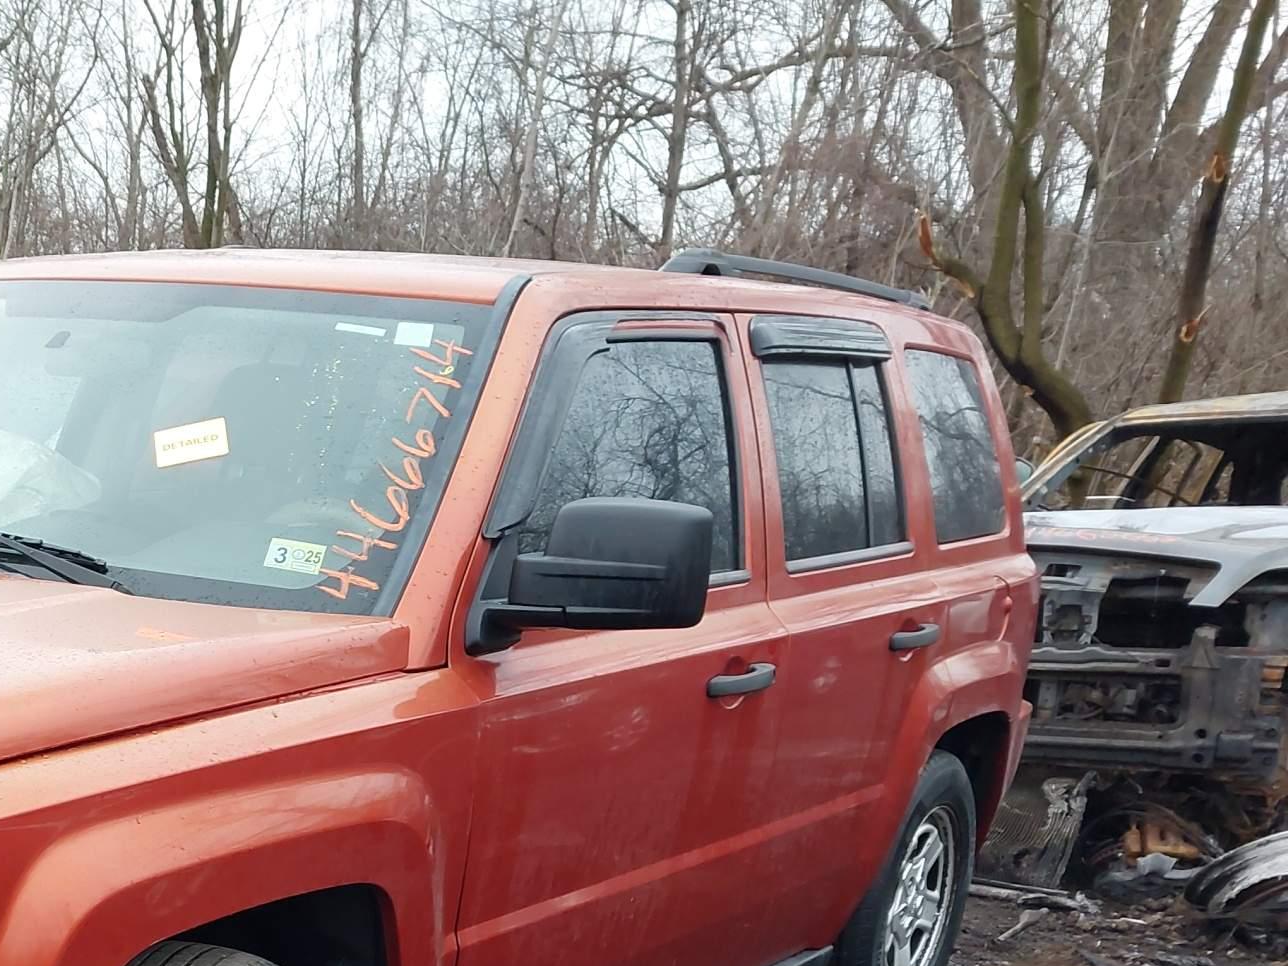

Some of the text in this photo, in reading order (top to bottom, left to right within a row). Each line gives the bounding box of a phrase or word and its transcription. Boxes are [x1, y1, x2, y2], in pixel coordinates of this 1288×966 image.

[162, 434, 219, 452] DETAILED
[316, 339, 473, 600] 44666714
[273, 546, 322, 564] 3 25
